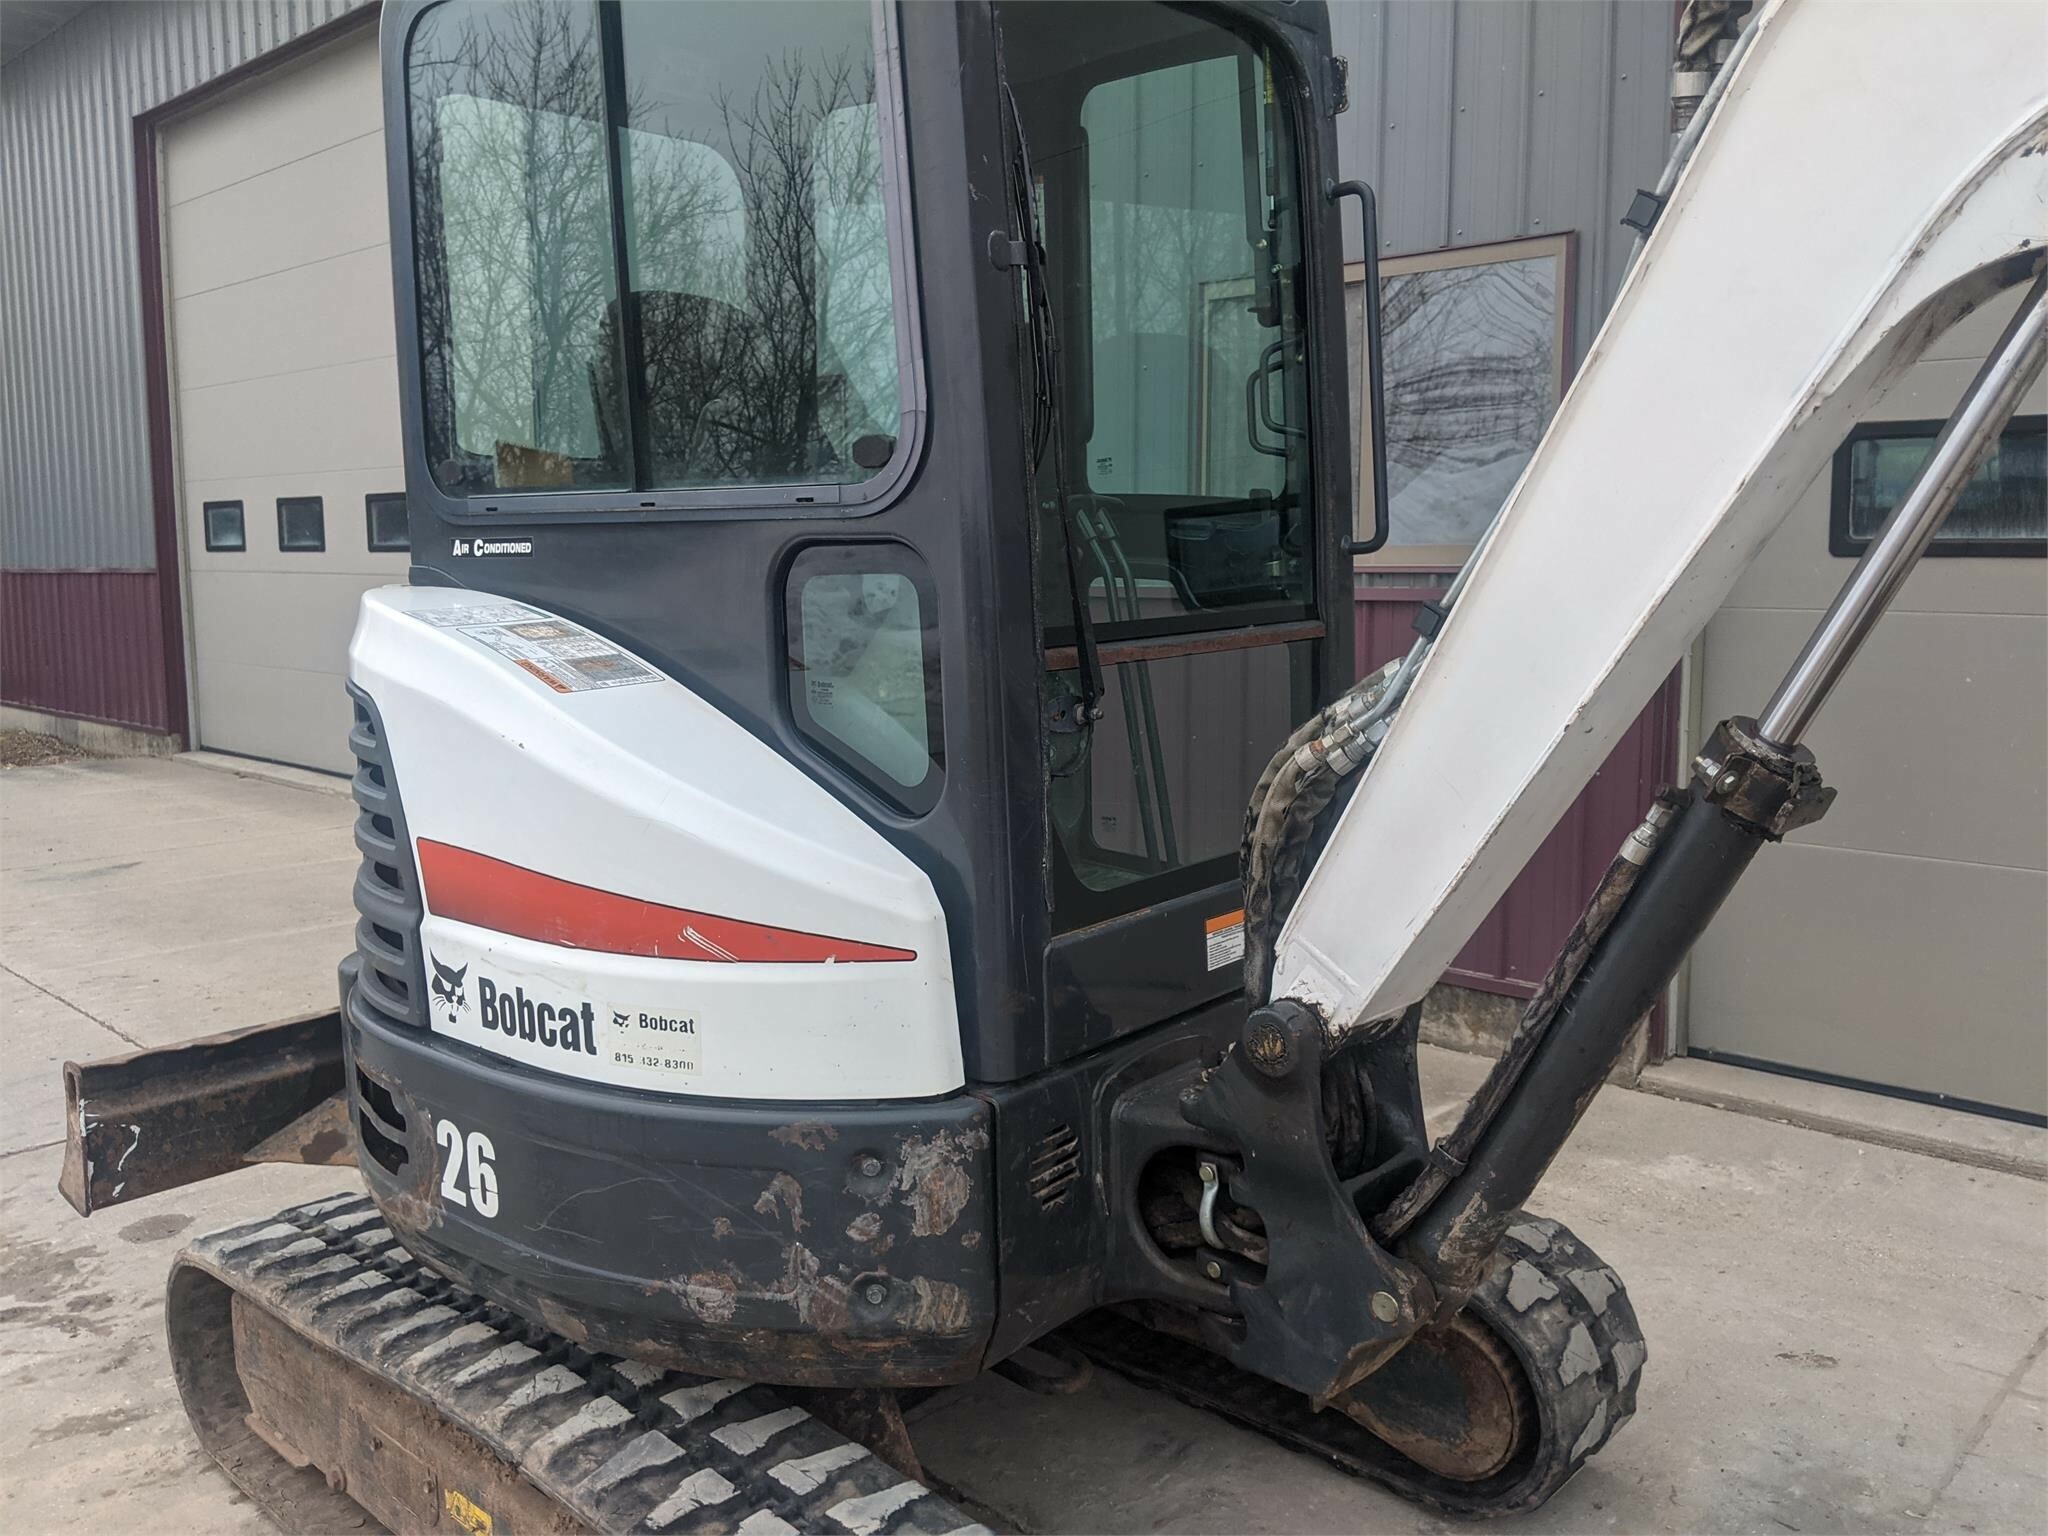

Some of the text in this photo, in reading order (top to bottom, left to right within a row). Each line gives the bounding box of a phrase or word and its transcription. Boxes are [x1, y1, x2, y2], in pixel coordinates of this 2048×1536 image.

[478, 976, 597, 1056] Bobcat
[639, 1012, 695, 1034] Bobcat
[614, 1051, 634, 1064] 815
[436, 1118, 499, 1219] 26
